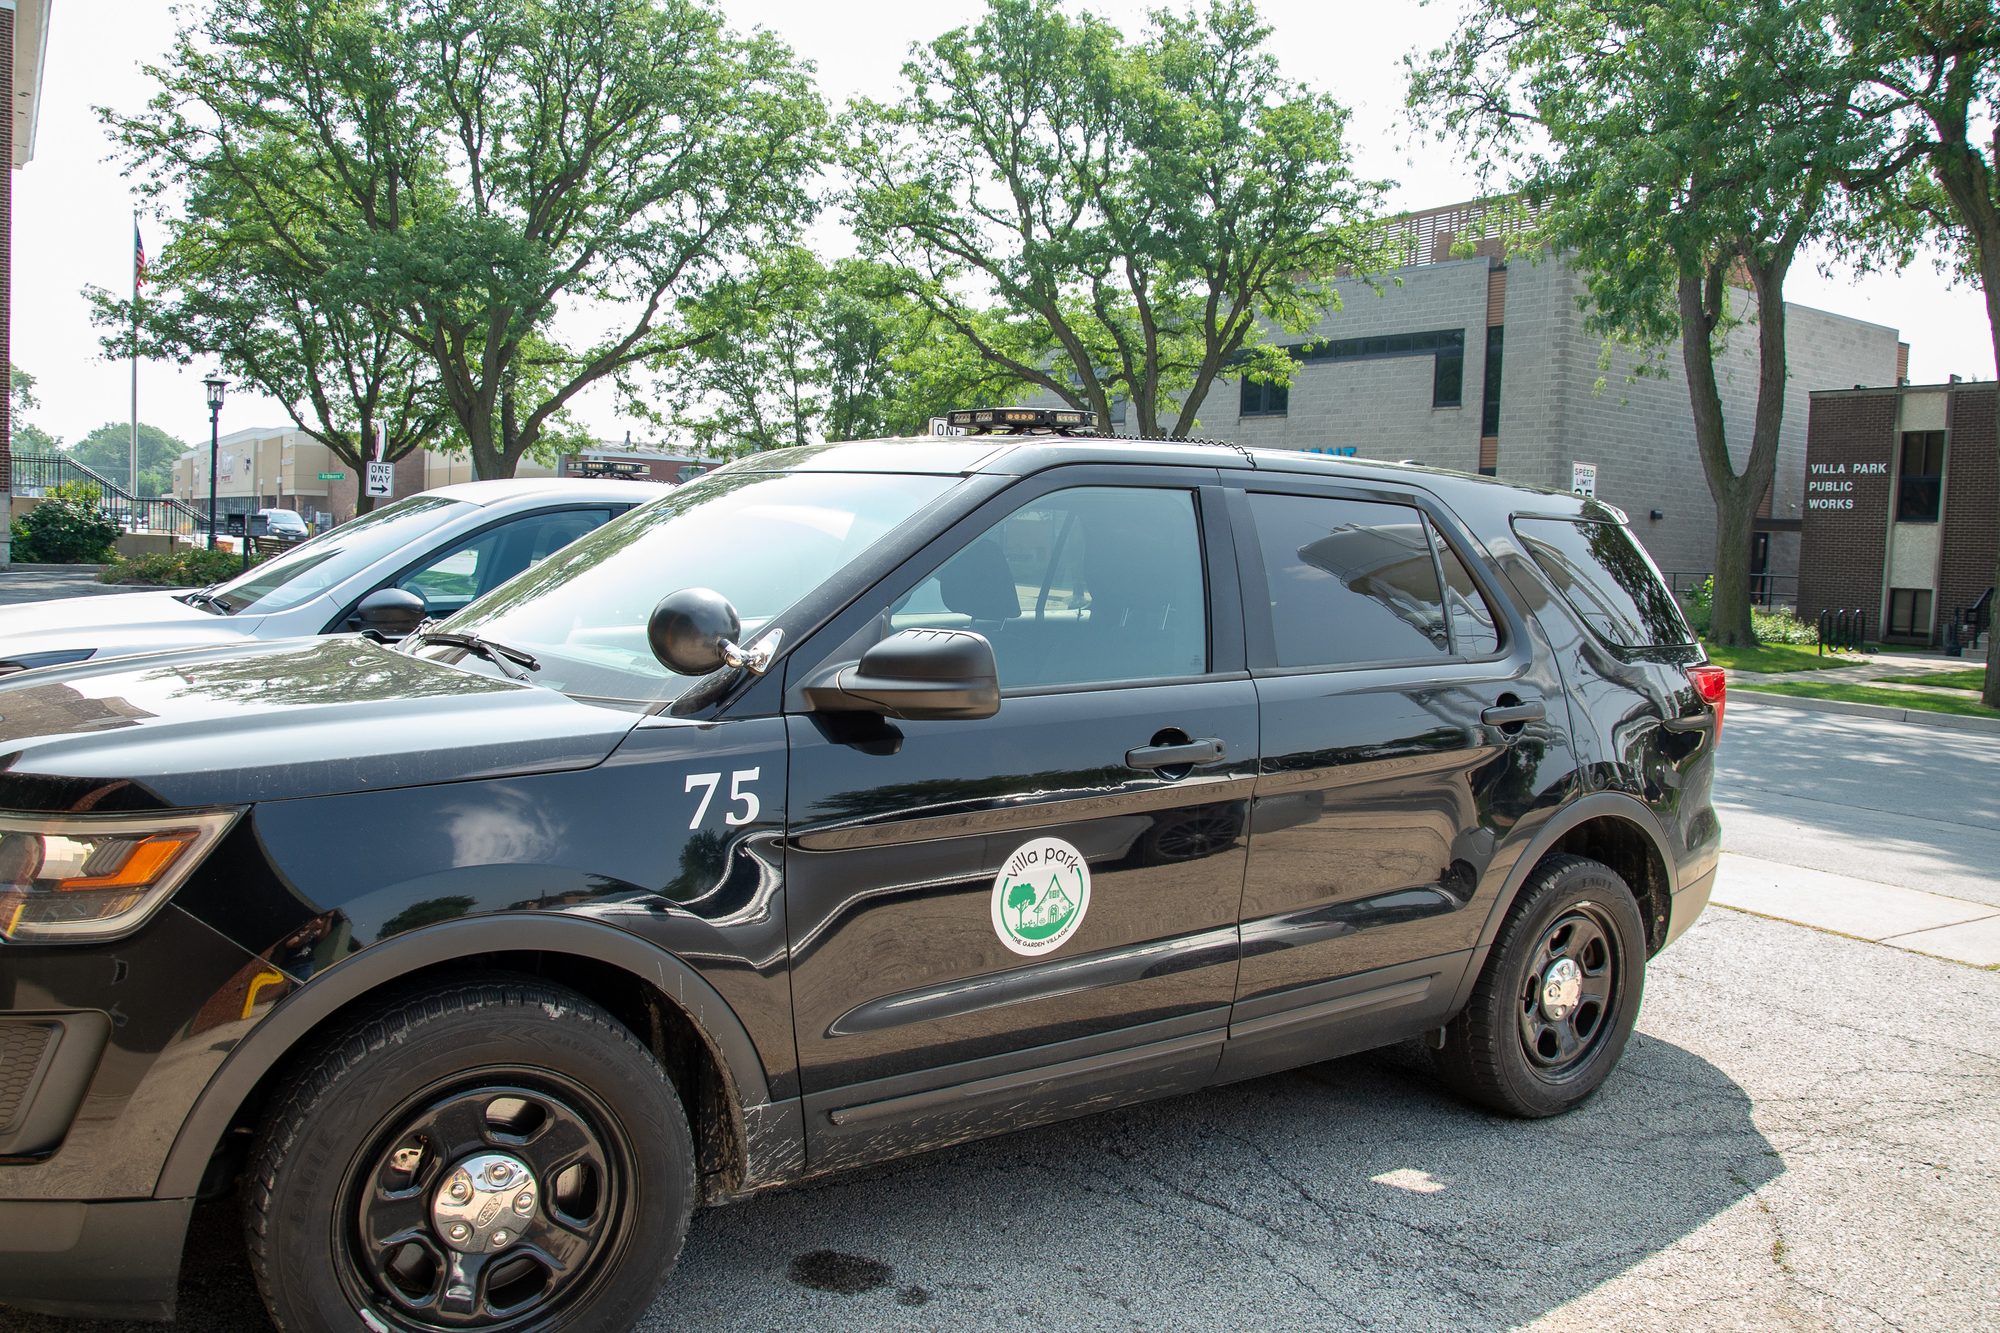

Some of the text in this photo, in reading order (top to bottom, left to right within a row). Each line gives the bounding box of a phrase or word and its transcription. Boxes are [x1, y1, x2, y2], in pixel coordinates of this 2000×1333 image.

[937, 423, 960, 436] ONE
[371, 464, 391, 474] ONE
[1574, 468, 1595, 478] SPEED
[1811, 463, 1887, 474] VILLA PARK
[370, 474, 391, 484] WAY
[1576, 479, 1592, 487] LIMIT
[1808, 481, 1854, 492] PUBLIC
[1808, 499, 1854, 510] WORKS
[684, 766, 760, 830] 75
[1007, 847, 1079, 878] villa park
[1012, 927, 1069, 948] THE GARDEN VILLAGE
